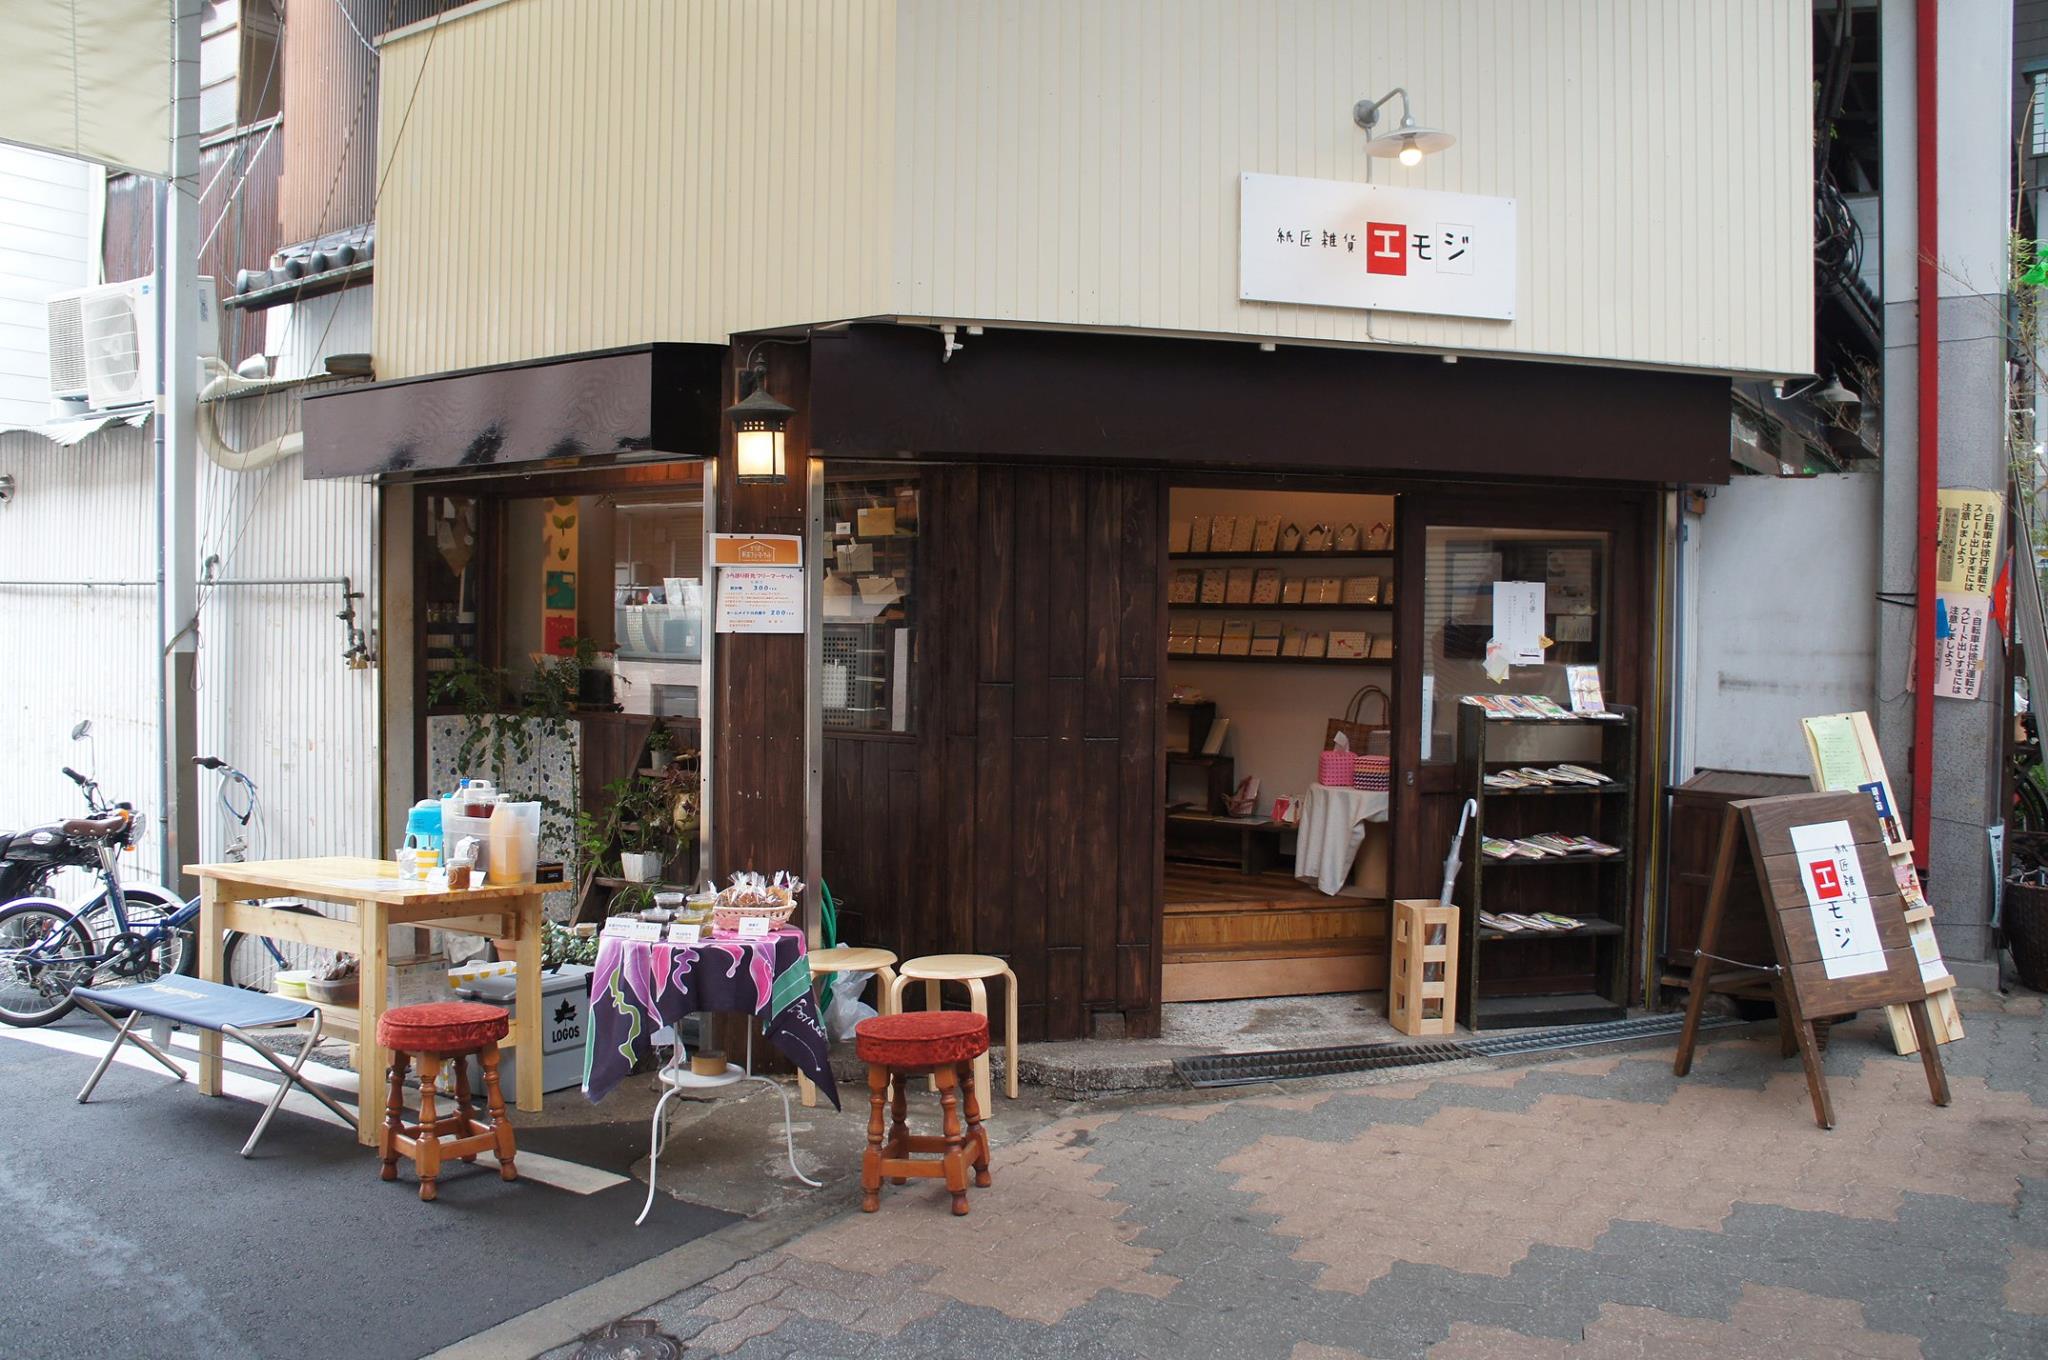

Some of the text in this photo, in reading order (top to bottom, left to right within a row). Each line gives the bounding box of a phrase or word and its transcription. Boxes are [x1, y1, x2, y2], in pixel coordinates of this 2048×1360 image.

[1276, 227, 1470, 261] 紙匠雑貨 エモジ
[1815, 866, 1852, 949] エモジ
[552, 1025, 581, 1043] LOGOS
